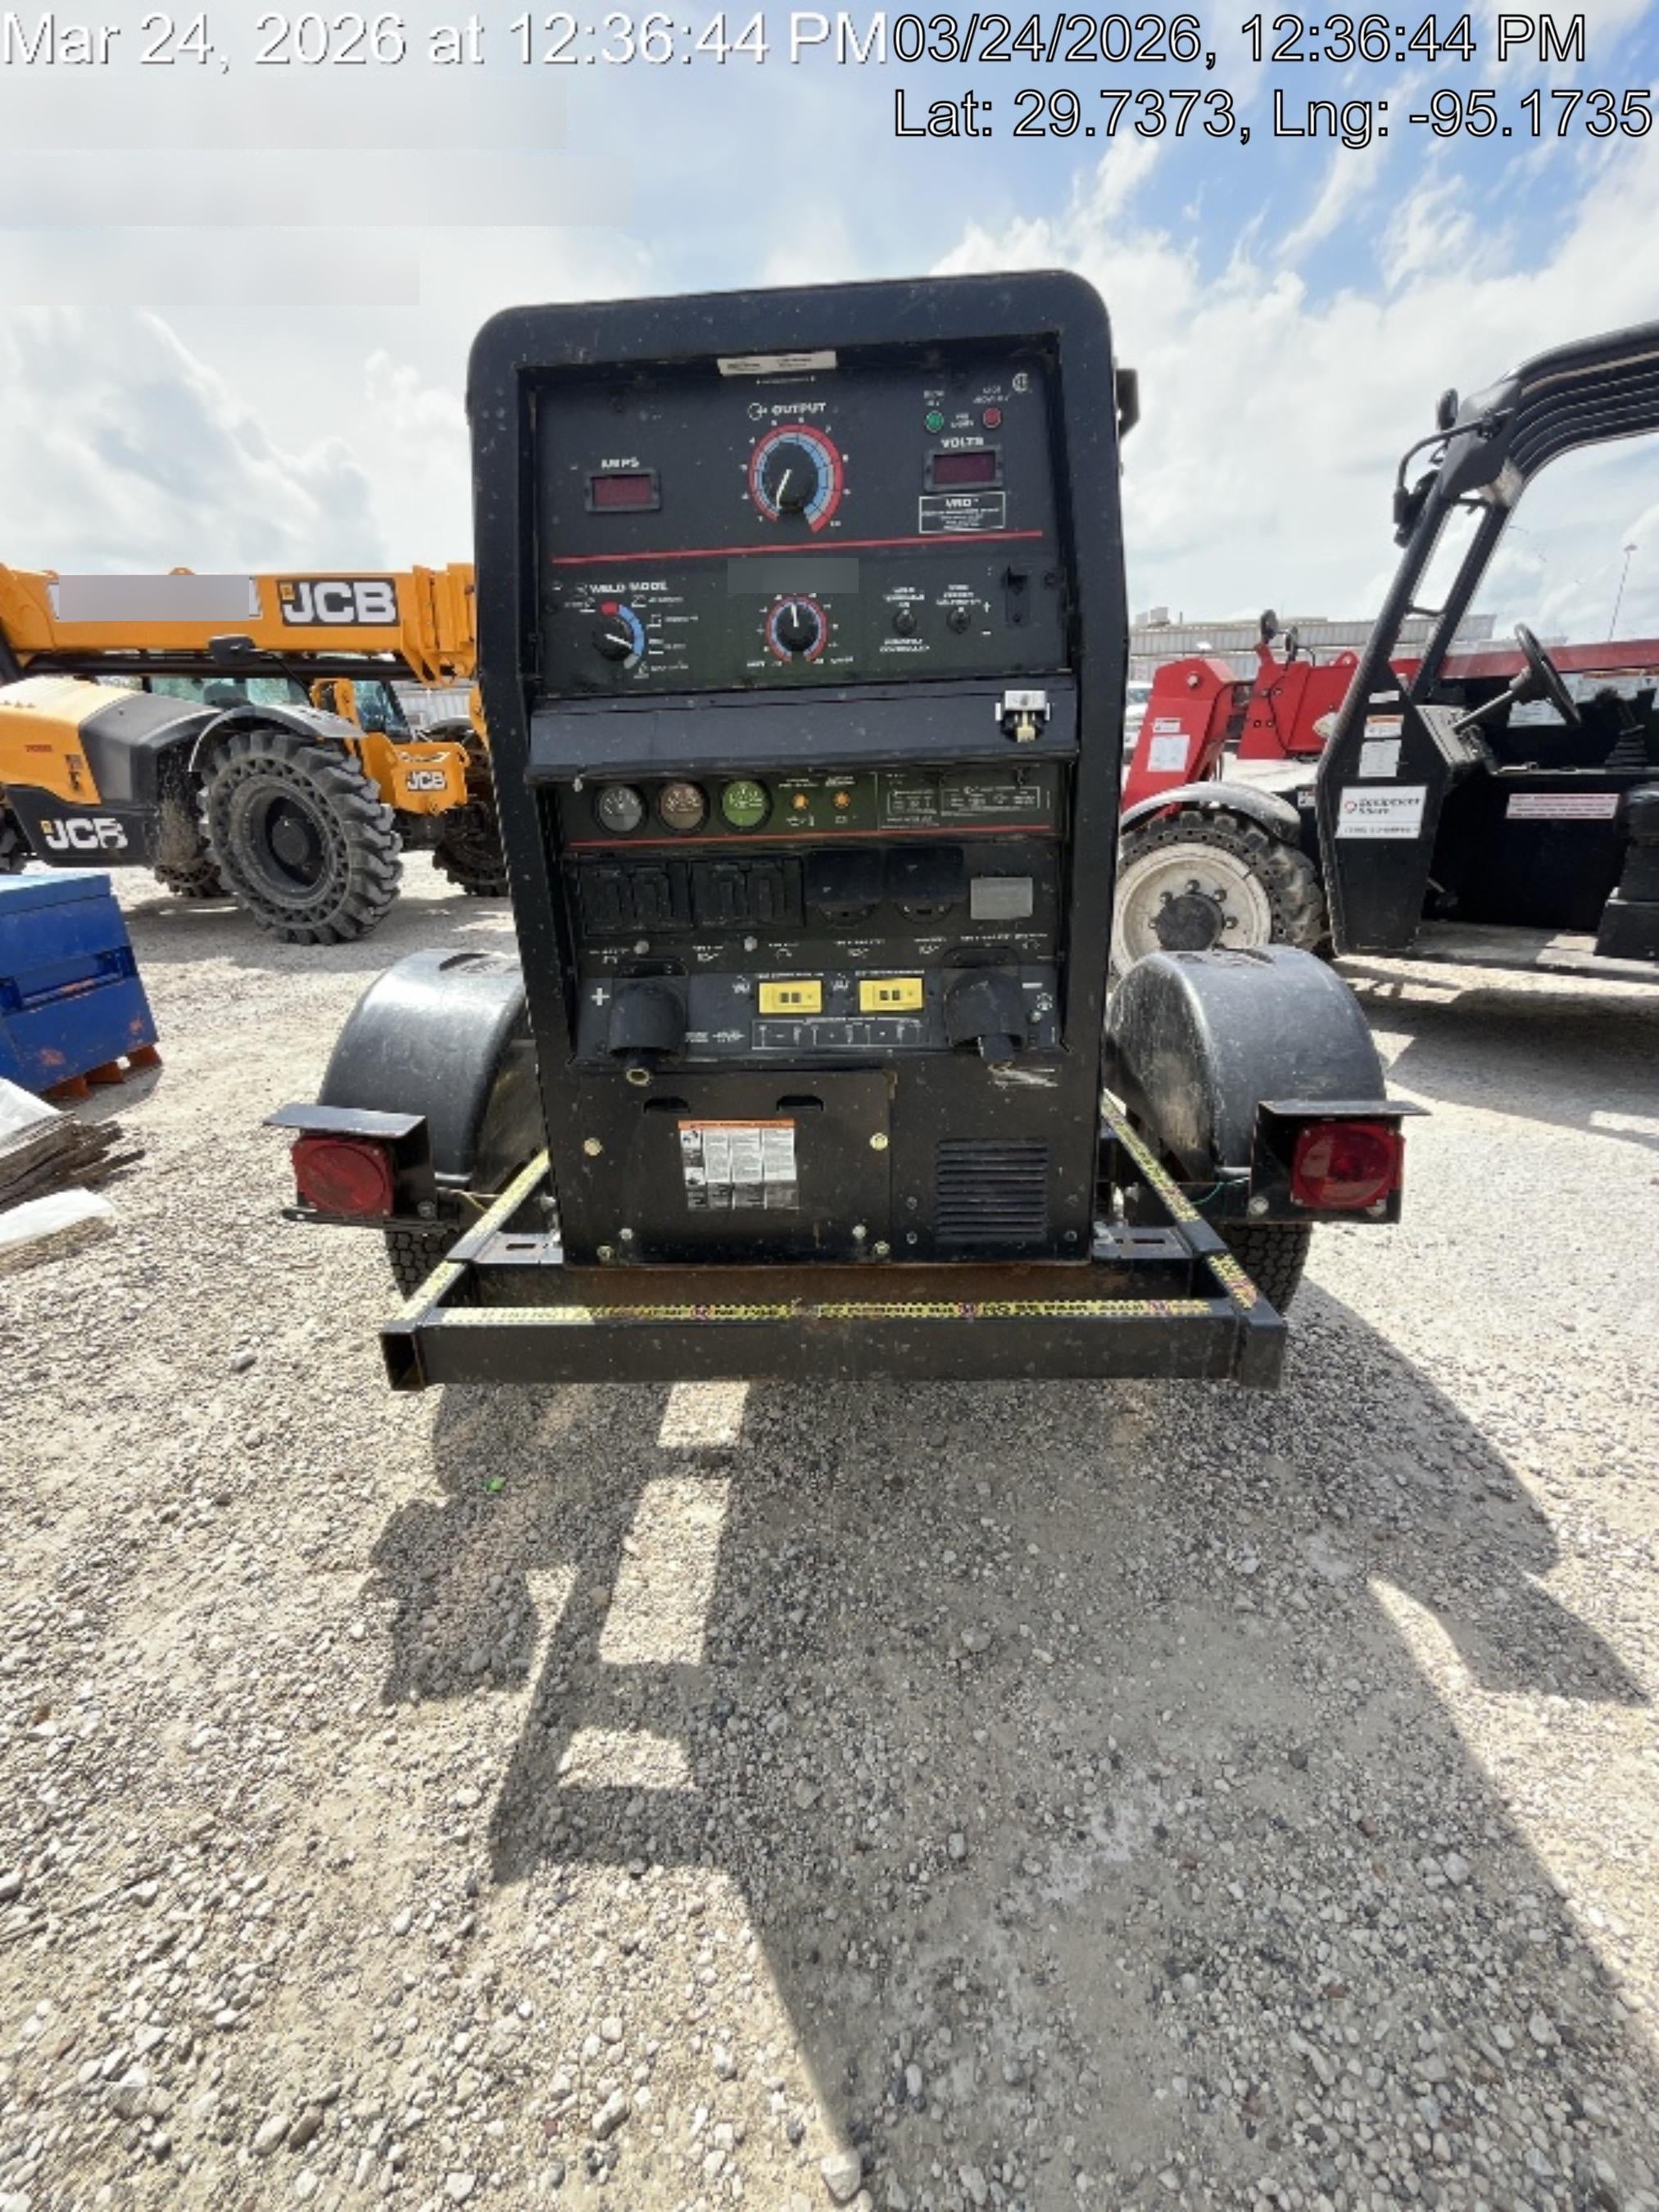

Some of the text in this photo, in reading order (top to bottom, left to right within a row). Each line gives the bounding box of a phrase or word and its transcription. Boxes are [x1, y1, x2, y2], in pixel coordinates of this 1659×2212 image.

[282, 582, 397, 623] JCB
[407, 770, 446, 790] JCB
[45, 818, 129, 849] JCB
